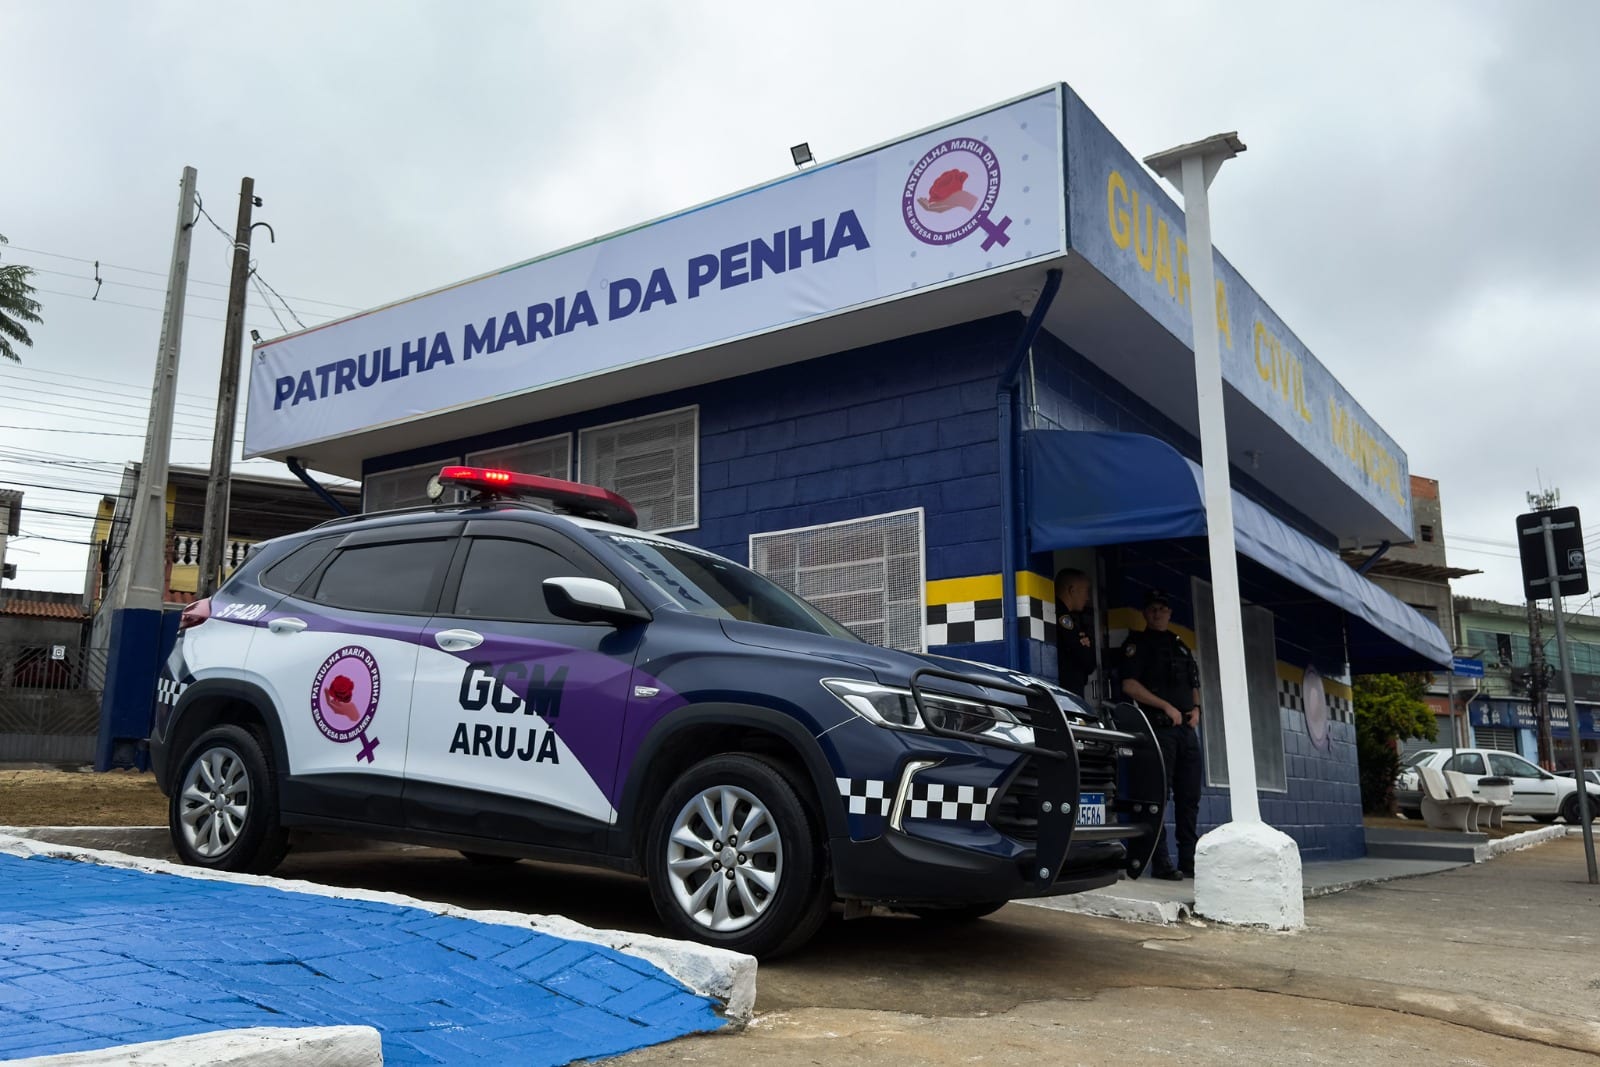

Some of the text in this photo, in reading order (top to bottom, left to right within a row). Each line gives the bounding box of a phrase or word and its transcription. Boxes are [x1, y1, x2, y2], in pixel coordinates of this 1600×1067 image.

[905, 140, 998, 212] PATRULHA MARIA DA PENHA
[909, 217, 931, 240] DEFESA
[945, 219, 978, 240] MULHER
[273, 209, 870, 411] PATRULHA MARIA DA PENHA
[1107, 171, 1233, 349] GUARA
[1254, 320, 1312, 424] CIVIL
[312, 648, 379, 704] PATRULHA MARIA DA PENHA
[459, 661, 569, 718] GCM
[318, 720, 338, 739] DEFESA
[348, 714, 371, 738] MULHER
[449, 722, 560, 765] ARUJÁ
